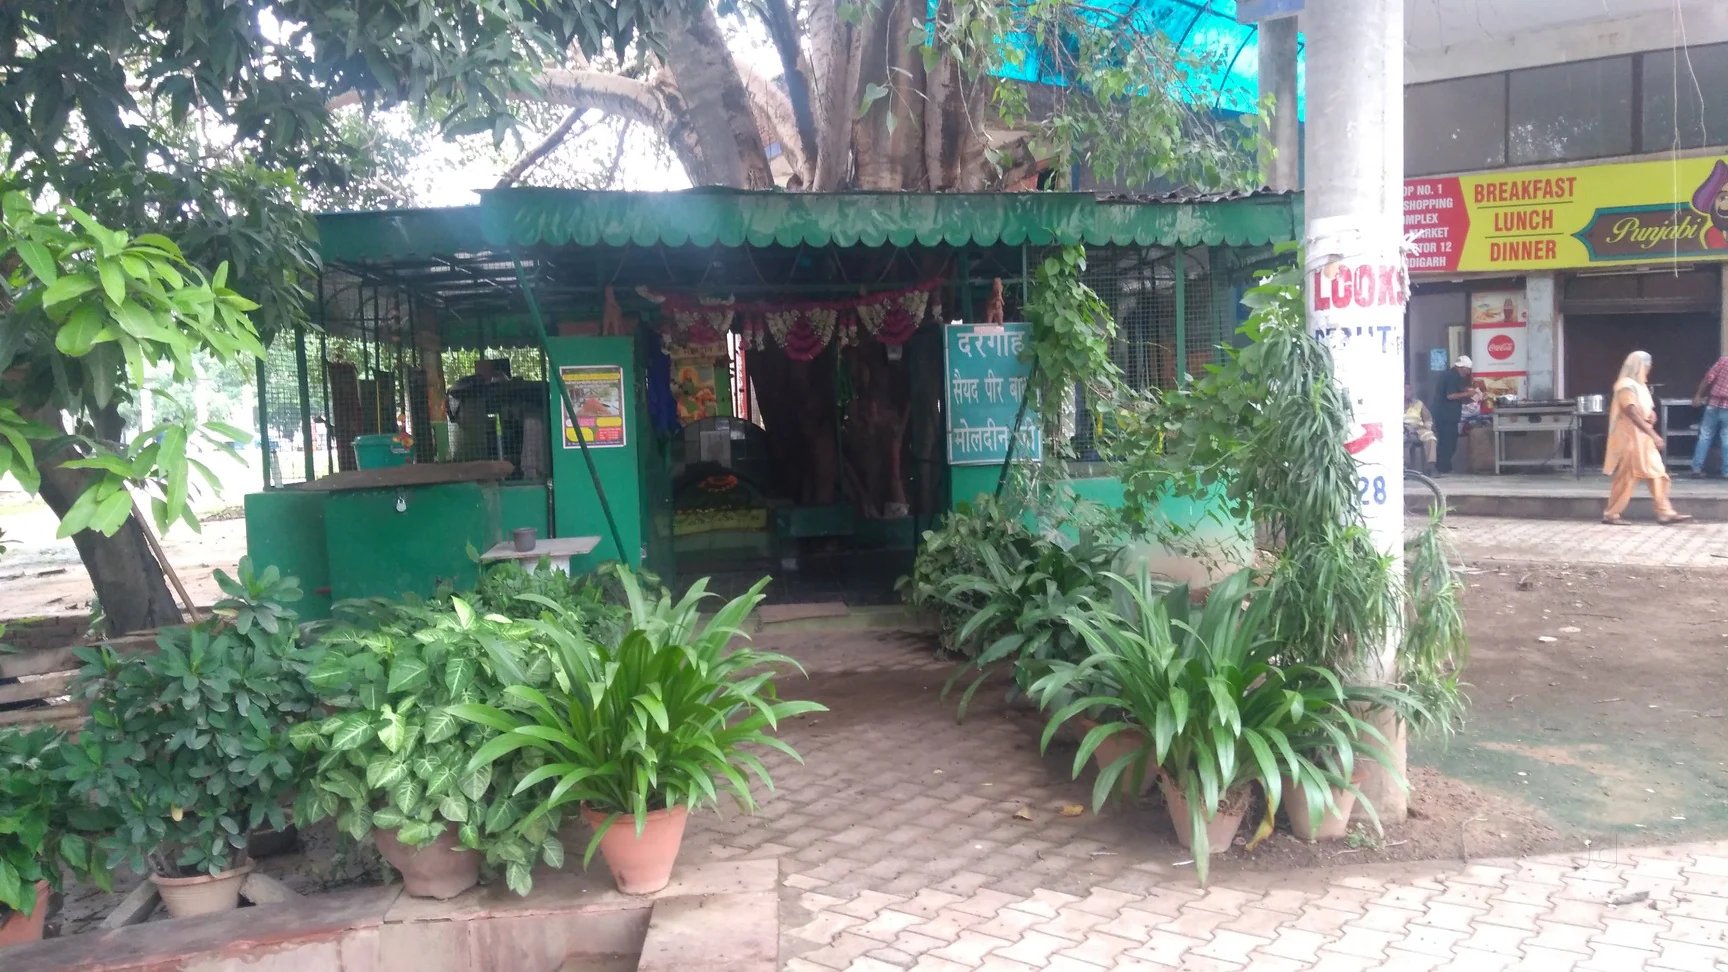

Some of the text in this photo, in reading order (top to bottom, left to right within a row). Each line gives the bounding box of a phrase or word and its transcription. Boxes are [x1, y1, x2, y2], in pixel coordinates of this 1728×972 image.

[1416, 184, 1434, 196] NO.
[1437, 183, 1443, 194] 1
[1473, 177, 1577, 204] BREAKFAST
[1403, 197, 1453, 210] SHOPPING
[1403, 212, 1439, 225] MPLEX
[1493, 209, 1554, 233] LUNCH
[1606, 215, 1701, 249] Punjabi
[1440, 241, 1453, 252] 12
[1490, 240, 1557, 262] DINNER
[956, 331, 1025, 358] दरगाह
[984, 369, 1004, 404] पीर
